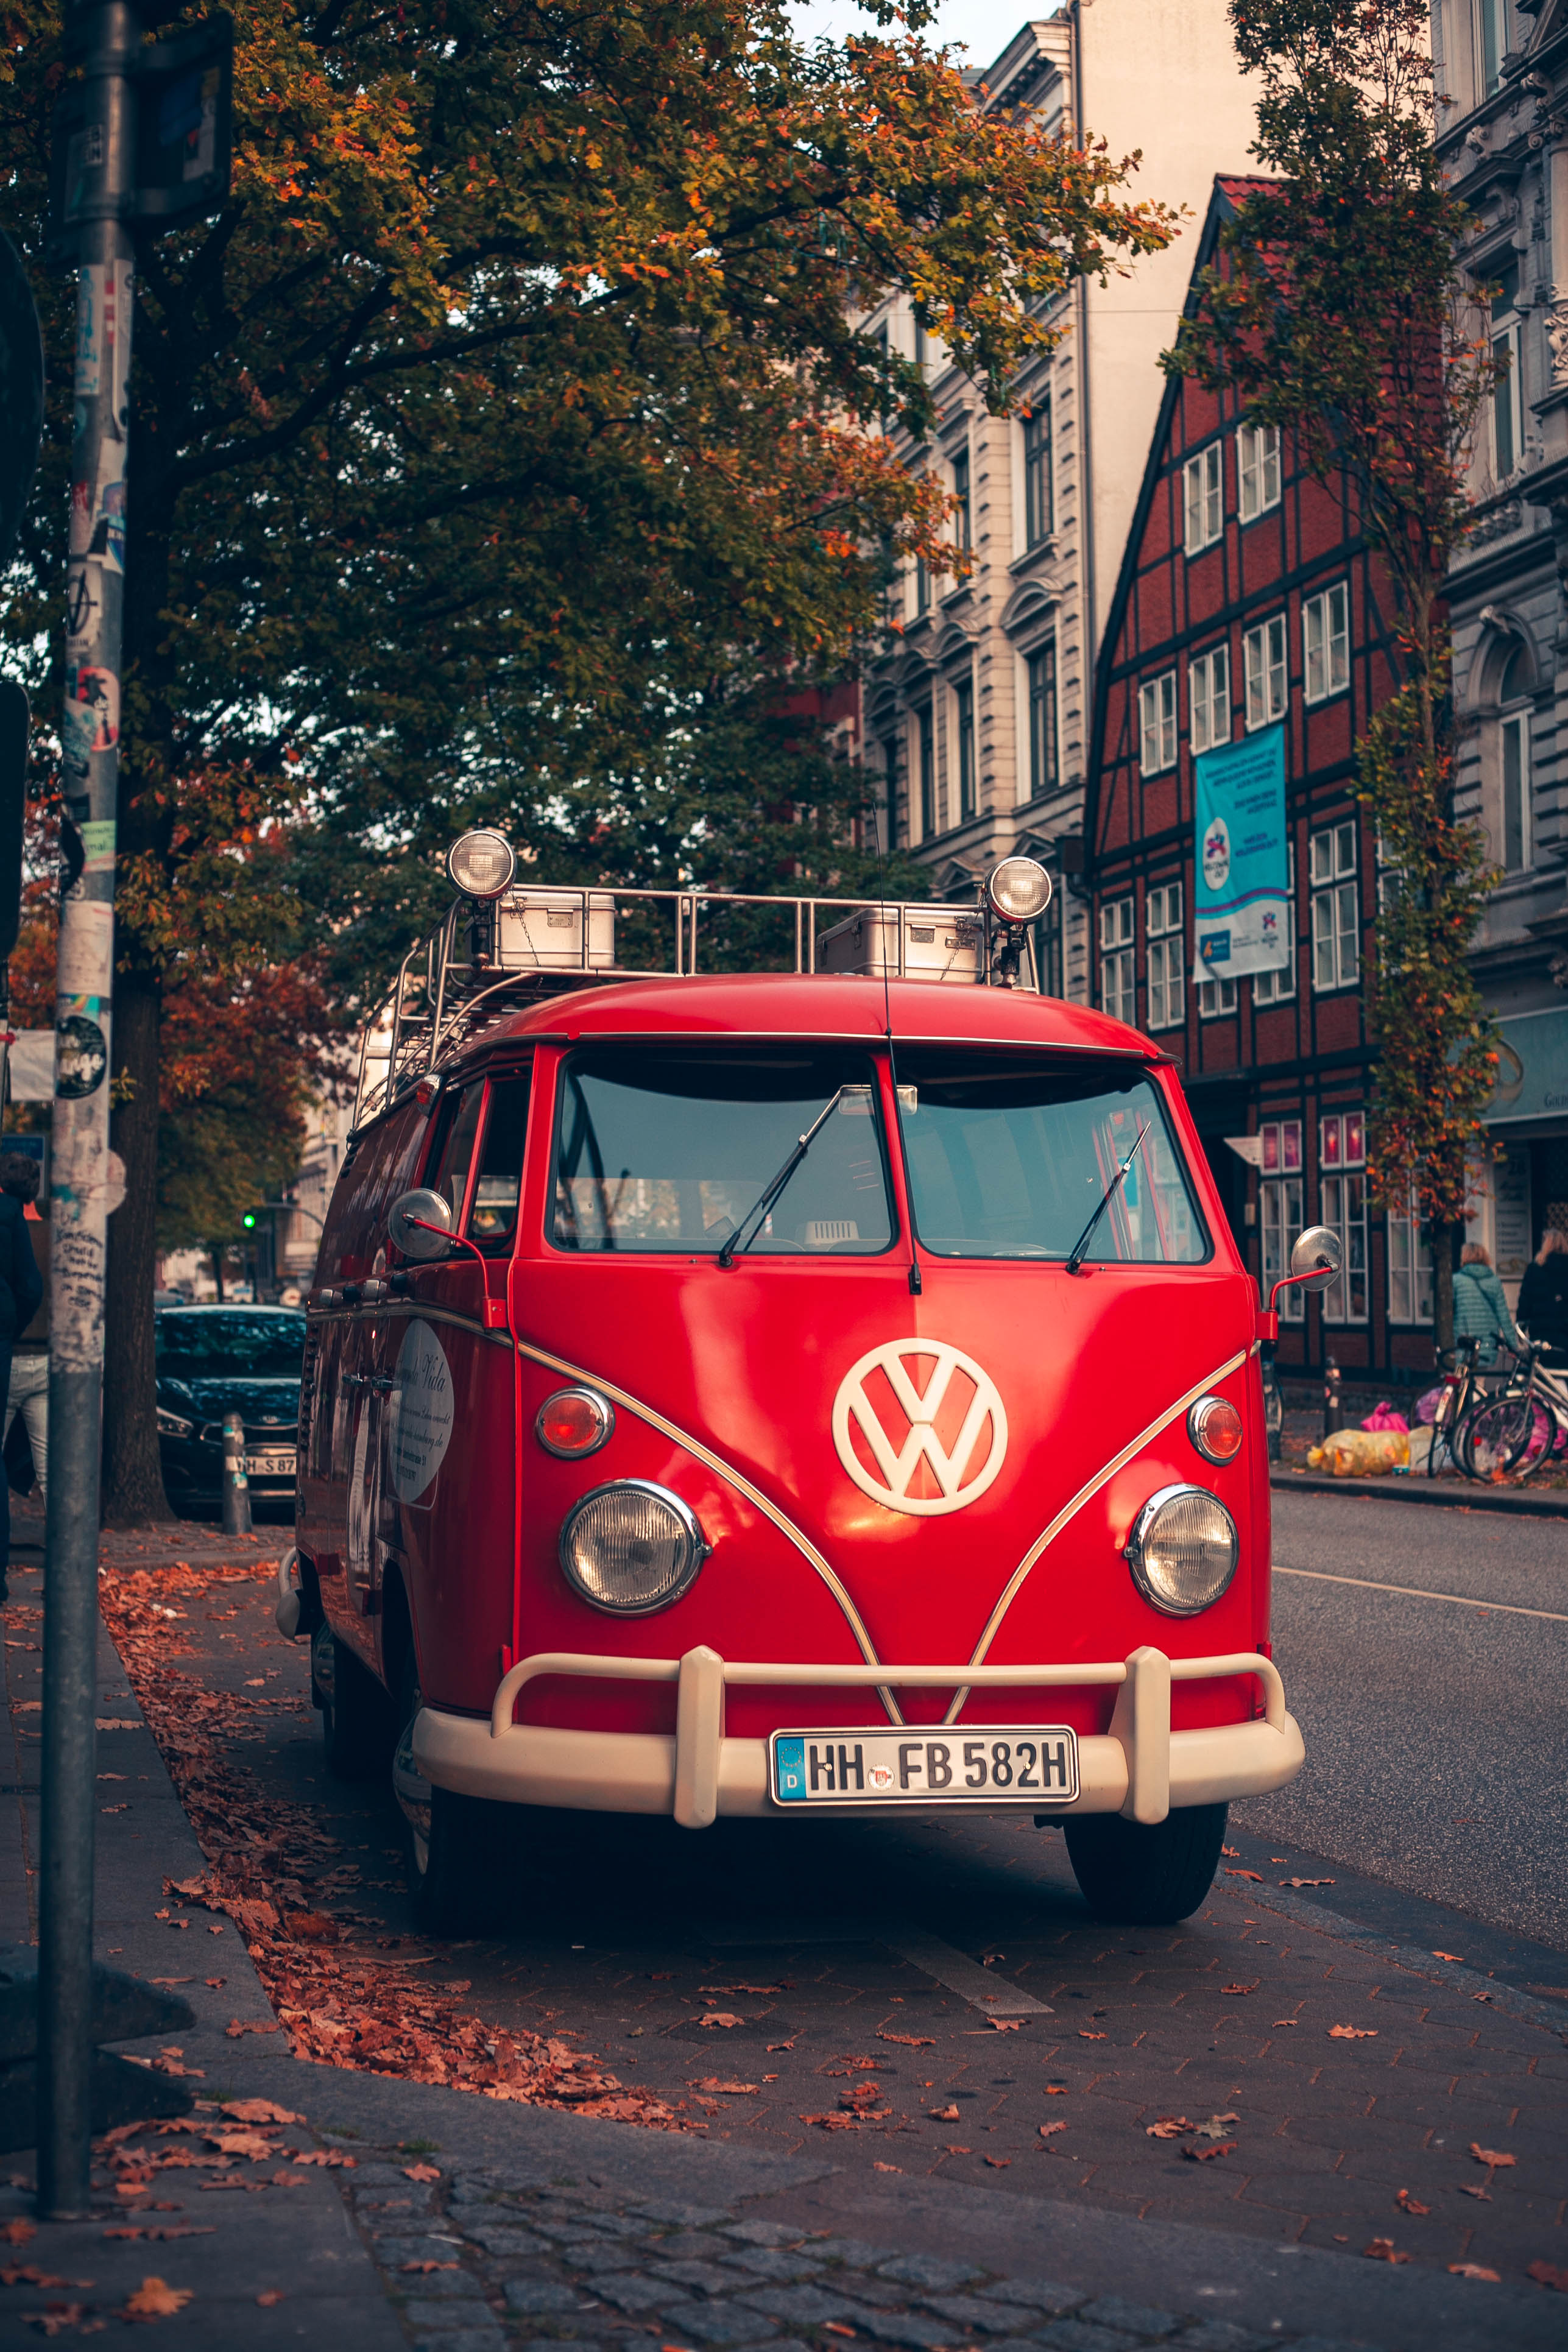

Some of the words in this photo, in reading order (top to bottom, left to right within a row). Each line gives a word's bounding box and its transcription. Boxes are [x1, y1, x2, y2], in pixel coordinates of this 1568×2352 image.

[422, 1353, 447, 1393] Vida
[832, 1338, 1008, 1516] VW
[247, 1460, 256, 1472] H
[265, 1460, 274, 1472] S
[277, 1460, 295, 1472] 87
[787, 1775, 797, 1789] D
[810, 1744, 865, 1790] HH
[899, 1743, 952, 1789] FB
[962, 1742, 1067, 1787] 582H
